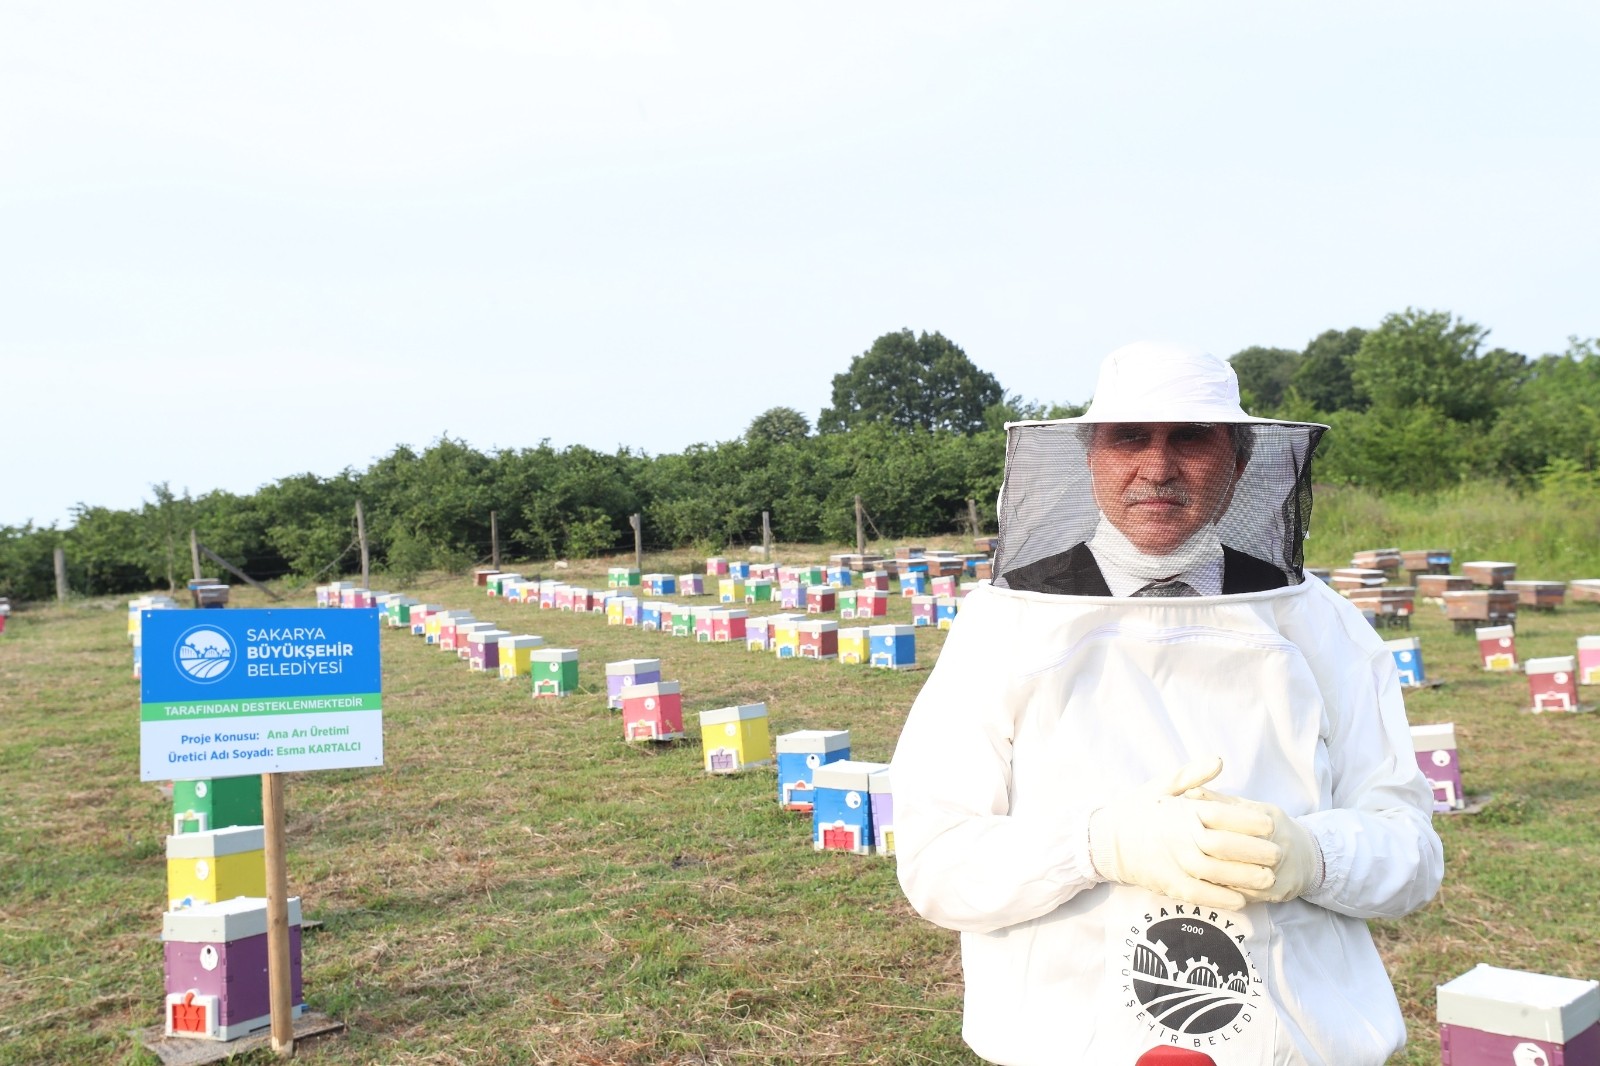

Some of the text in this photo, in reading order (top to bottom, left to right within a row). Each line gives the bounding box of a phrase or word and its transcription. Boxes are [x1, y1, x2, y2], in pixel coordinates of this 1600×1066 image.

[247, 628, 326, 641] SAKARYA
[247, 641, 353, 660] BÜYÜKŞEHİR
[248, 659, 342, 677] BELEDİYESİ
[165, 697, 362, 716] TARAFINDAN DESTEKLENMEKTEDİR
[181, 726, 349, 745] Proje Konusu: Ana Arı Üretimi
[169, 742, 361, 763] Üretici Adı Soyadı: Esma KARTALCI
[1144, 904, 1245, 943] SAKARYA
[1181, 924, 1204, 935] 2000
